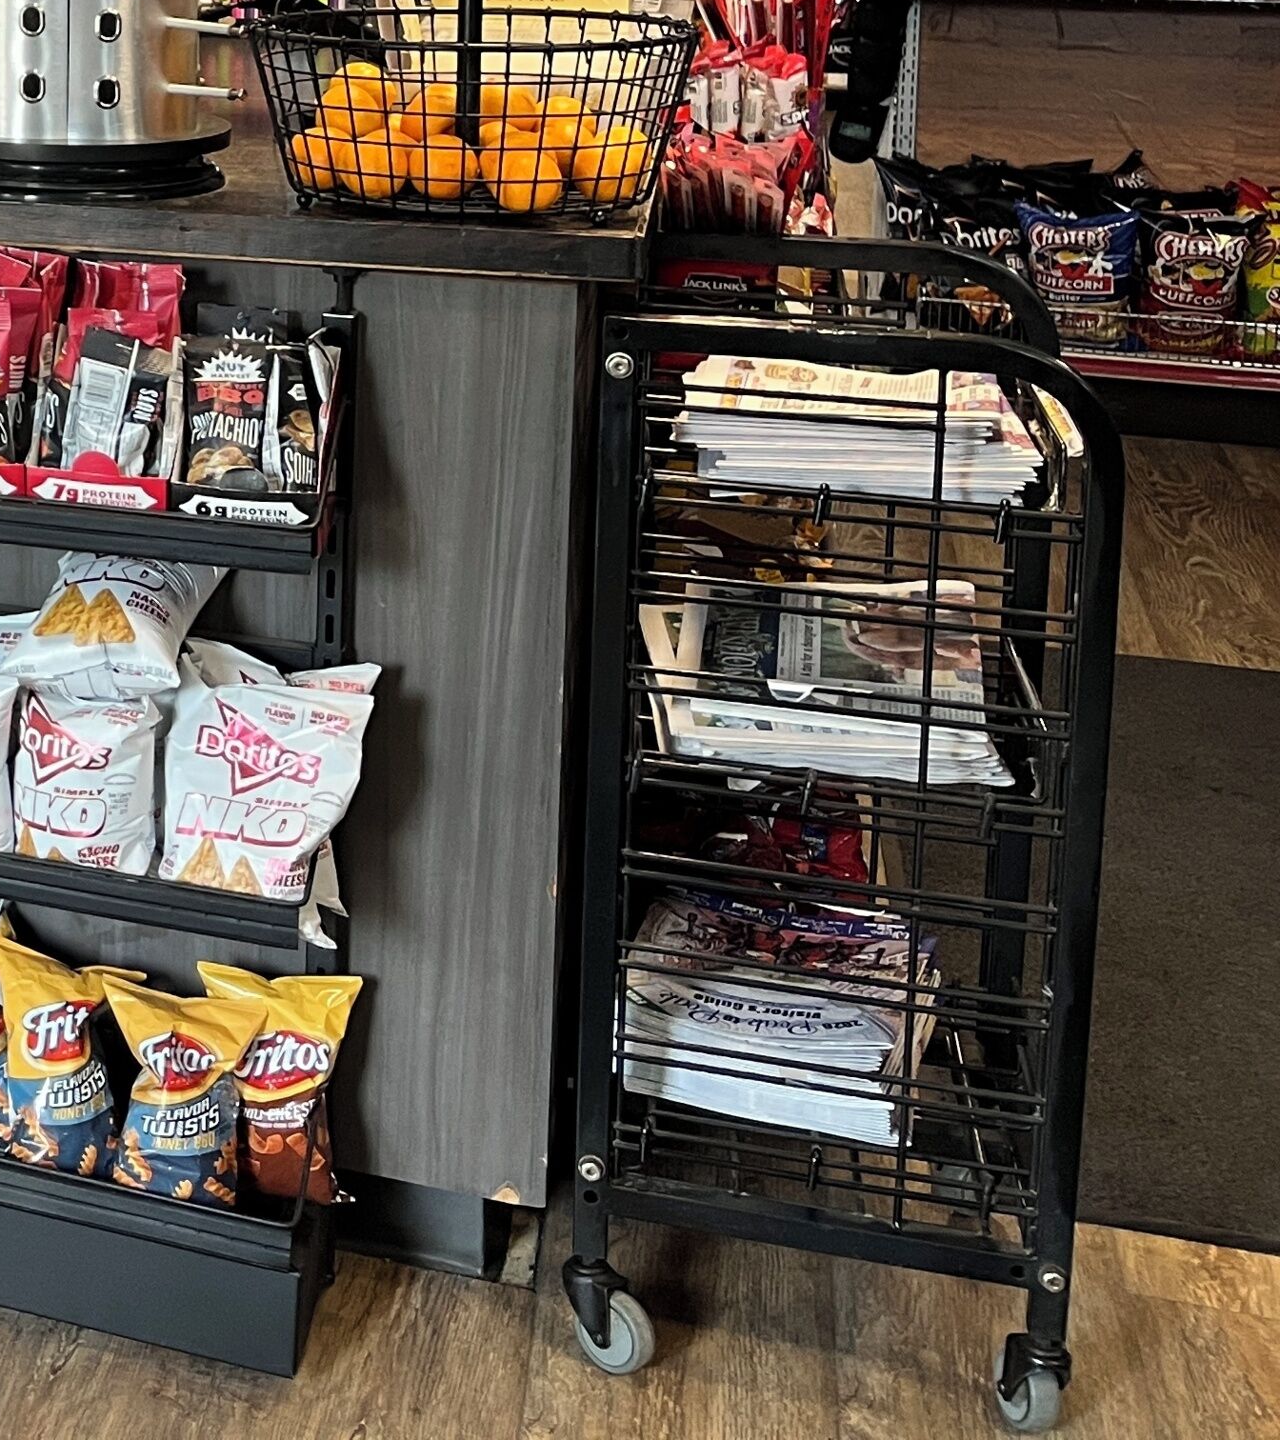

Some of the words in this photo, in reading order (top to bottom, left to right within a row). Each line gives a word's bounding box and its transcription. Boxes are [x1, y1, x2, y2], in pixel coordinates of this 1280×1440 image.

[1030, 222, 1112, 248] CHESTER'S
[683, 278, 711, 292] JACK
[713, 280, 748, 293] LINK'S
[1049, 292, 1080, 303] Butter
[10, 354, 27, 389] NUTS
[215, 361, 247, 373] NUT
[134, 386, 158, 422] NUTS
[196, 383, 264, 404] BBQ
[82, 488, 137, 502] PROTEIN
[231, 505, 289, 519] PROTEIN
[196, 724, 322, 786] Doritos
[176, 792, 308, 848] NKD
[692, 992, 744, 1011] Guide
[743, 1004, 822, 1019] Visitor's
[236, 1033, 330, 1080] Fritos
[47, 1068, 107, 1109] TWISTS
[53, 1106, 87, 1122] HONEY
[156, 1098, 211, 1122] FLAVOR
[142, 1105, 221, 1139] TWISTS
